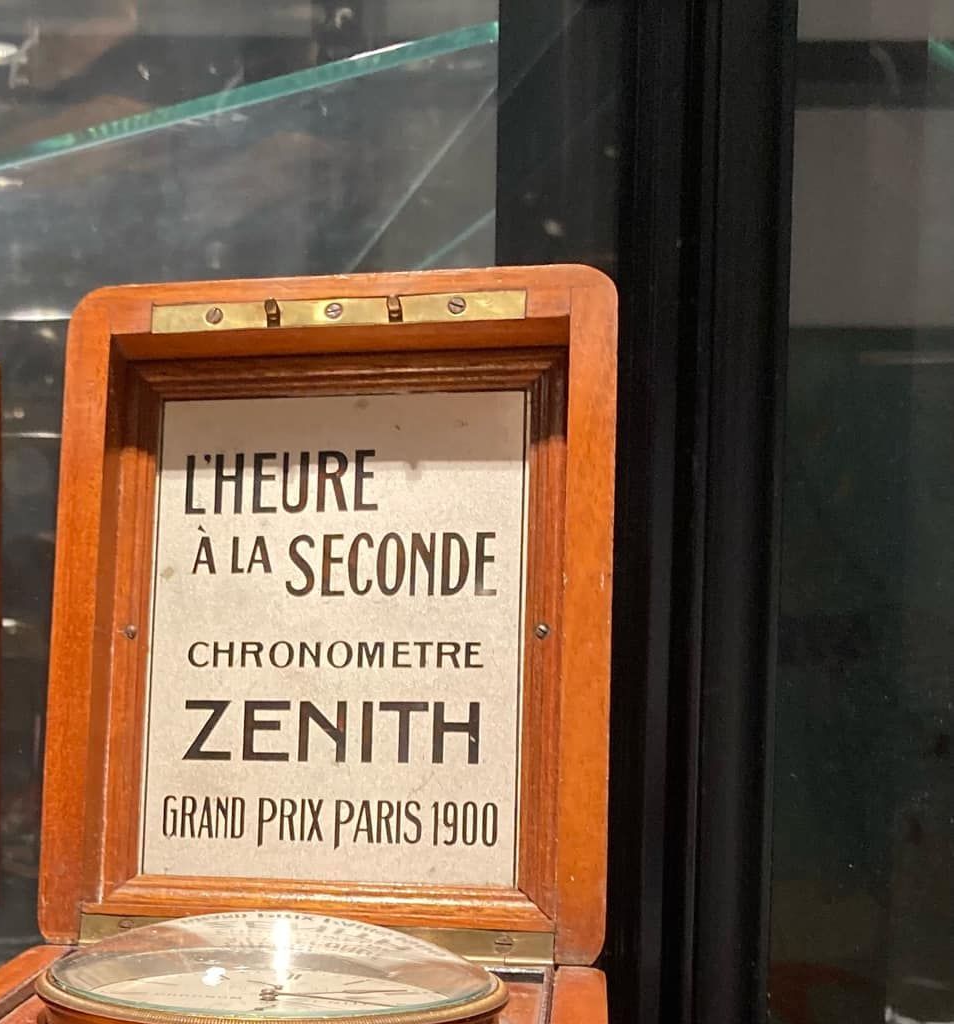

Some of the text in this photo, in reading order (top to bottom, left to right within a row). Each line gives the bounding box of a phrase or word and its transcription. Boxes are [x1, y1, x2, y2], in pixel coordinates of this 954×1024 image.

[184, 449, 379, 515] L'HEURE
[191, 526, 497, 597] À LA SECONDE
[187, 640, 484, 669] CHRONOMETRE
[181, 700, 481, 765] ZENITH
[162, 795, 499, 850] GRAND PRIX PARIS 1900
